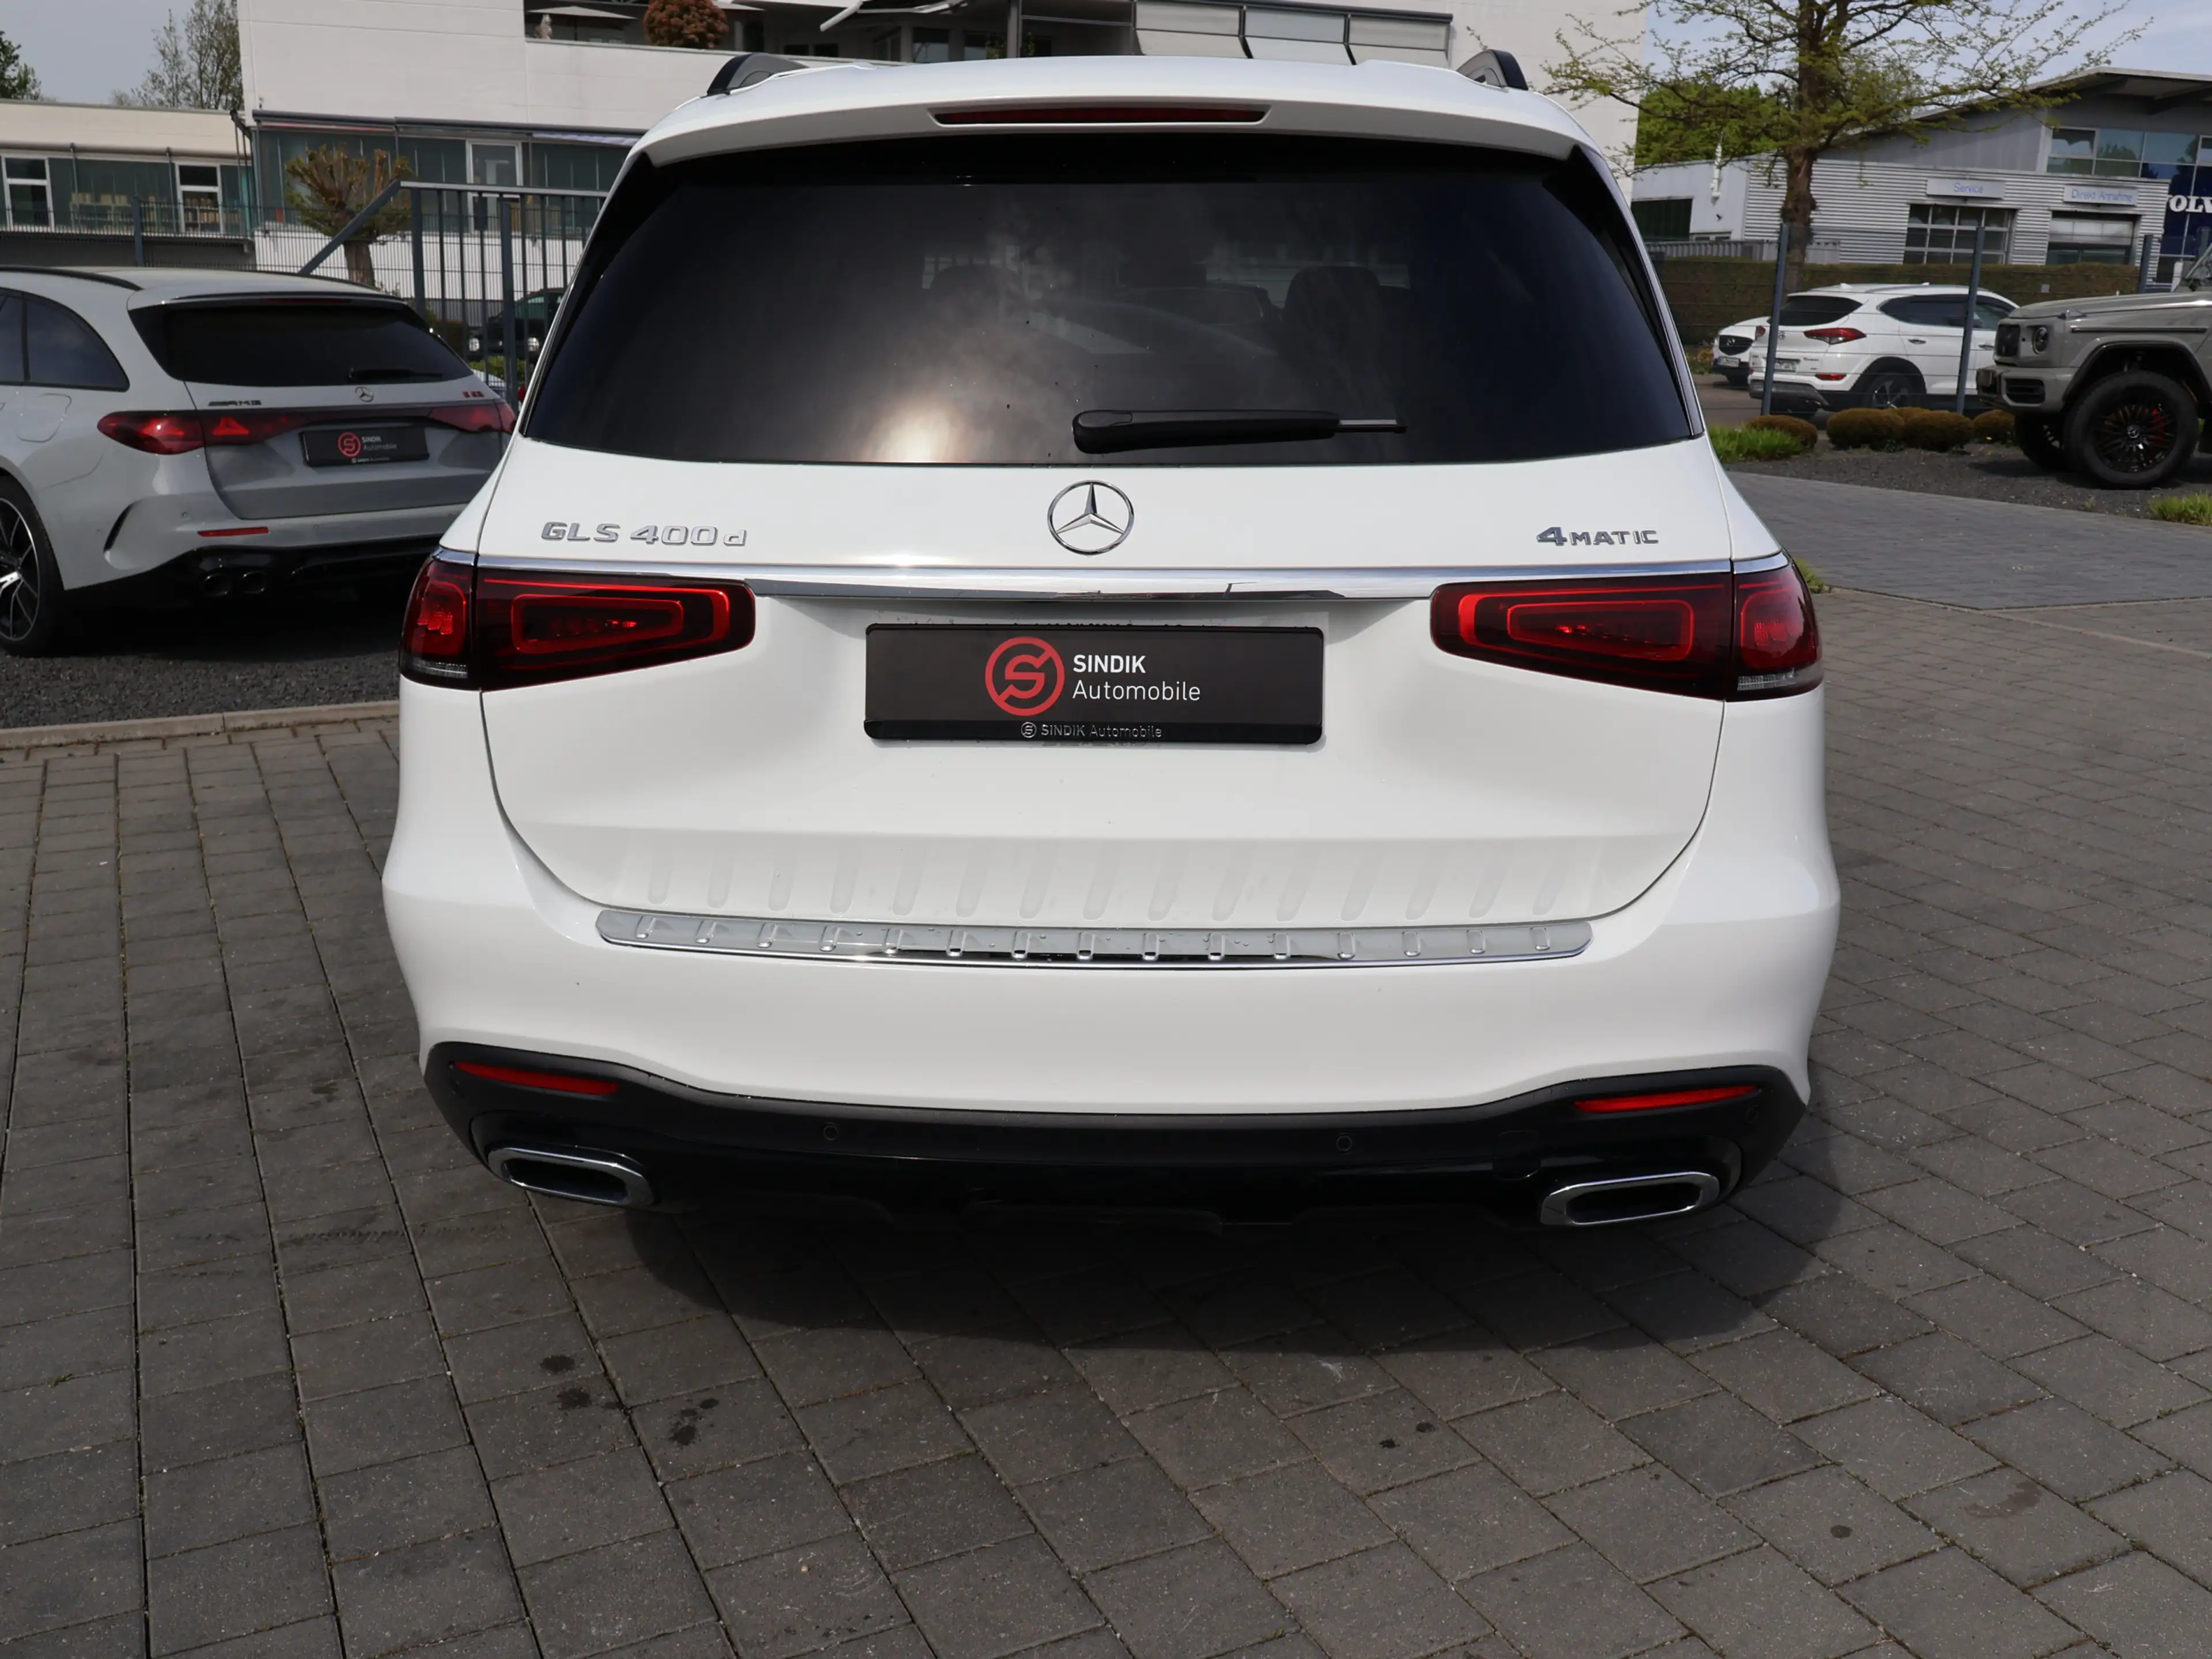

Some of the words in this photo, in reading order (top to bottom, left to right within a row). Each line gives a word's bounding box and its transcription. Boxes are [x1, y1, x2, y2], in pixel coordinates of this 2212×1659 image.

[1954, 182, 1983, 194] Service
[541, 521, 621, 542] GLS
[1536, 527, 1659, 546] 4MATIC
[1073, 654, 1146, 673] SINDIK
[1072, 680, 1200, 700] Automobile
[1041, 724, 1085, 737] SINDIK
[1089, 725, 1162, 737] Automobile
